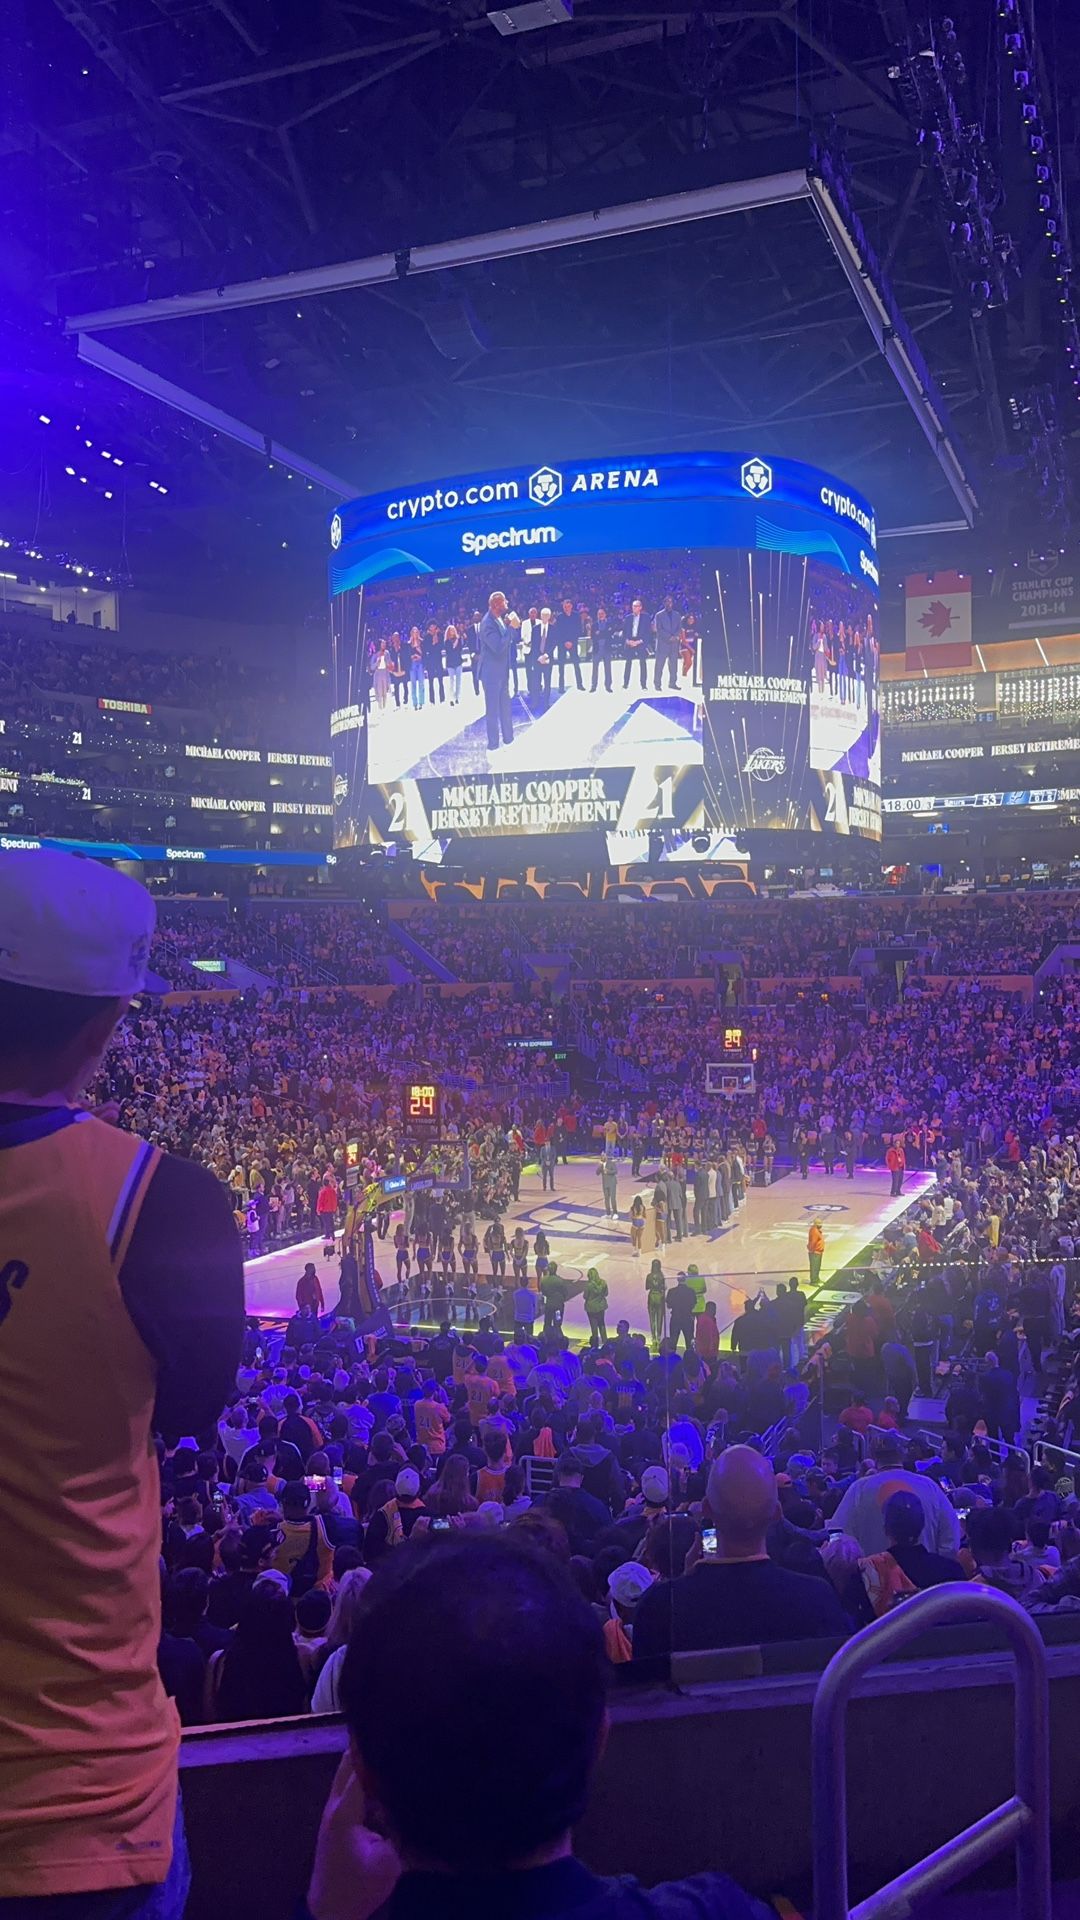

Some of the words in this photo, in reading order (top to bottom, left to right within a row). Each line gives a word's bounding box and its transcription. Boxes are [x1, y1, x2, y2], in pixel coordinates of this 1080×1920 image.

[387, 481, 518, 520] crypto.com
[571, 469, 659, 492] ARENA
[820, 487, 871, 536] crypto.com
[462, 526, 556, 556] Spectrum
[1012, 579, 1052, 591] STANLEY
[1055, 576, 1074, 588] CUP
[1012, 586, 1074, 601] CHAMPIONS
[1021, 601, 1066, 617] 2013-14
[717, 675, 767, 689] MICHAEL
[767, 677, 802, 692] COOPER
[709, 688, 749, 701] JERSEY
[750, 689, 807, 705] RETIREMENT
[103, 699, 148, 714] TOSHIBA
[72, 732, 82, 745] 21
[185, 745, 224, 760] MICHAEL
[224, 748, 261, 762] COOPER
[267, 752, 298, 765] JERSEY
[902, 748, 945, 762] MICHAEL
[945, 747, 984, 760] COOPER
[991, 743, 1026, 756] JERSEY
[82, 788, 91, 801] 21
[442, 783, 523, 808] MICHAEL
[525, 779, 606, 802] COOPER
[982, 795, 996, 805] 53
[191, 796, 229, 811] MICHAEL
[229, 799, 266, 813] COOPER
[272, 803, 304, 815] JERSEY
[431, 806, 491, 831] JERSEY
[495, 800, 620, 826] RETIREMENT
[1, 837, 41, 850] Spectrum
[166, 848, 205, 860] Spectrum
[411, 1086, 435, 1097] 18:00
[410, 1096, 433, 1115] 24
